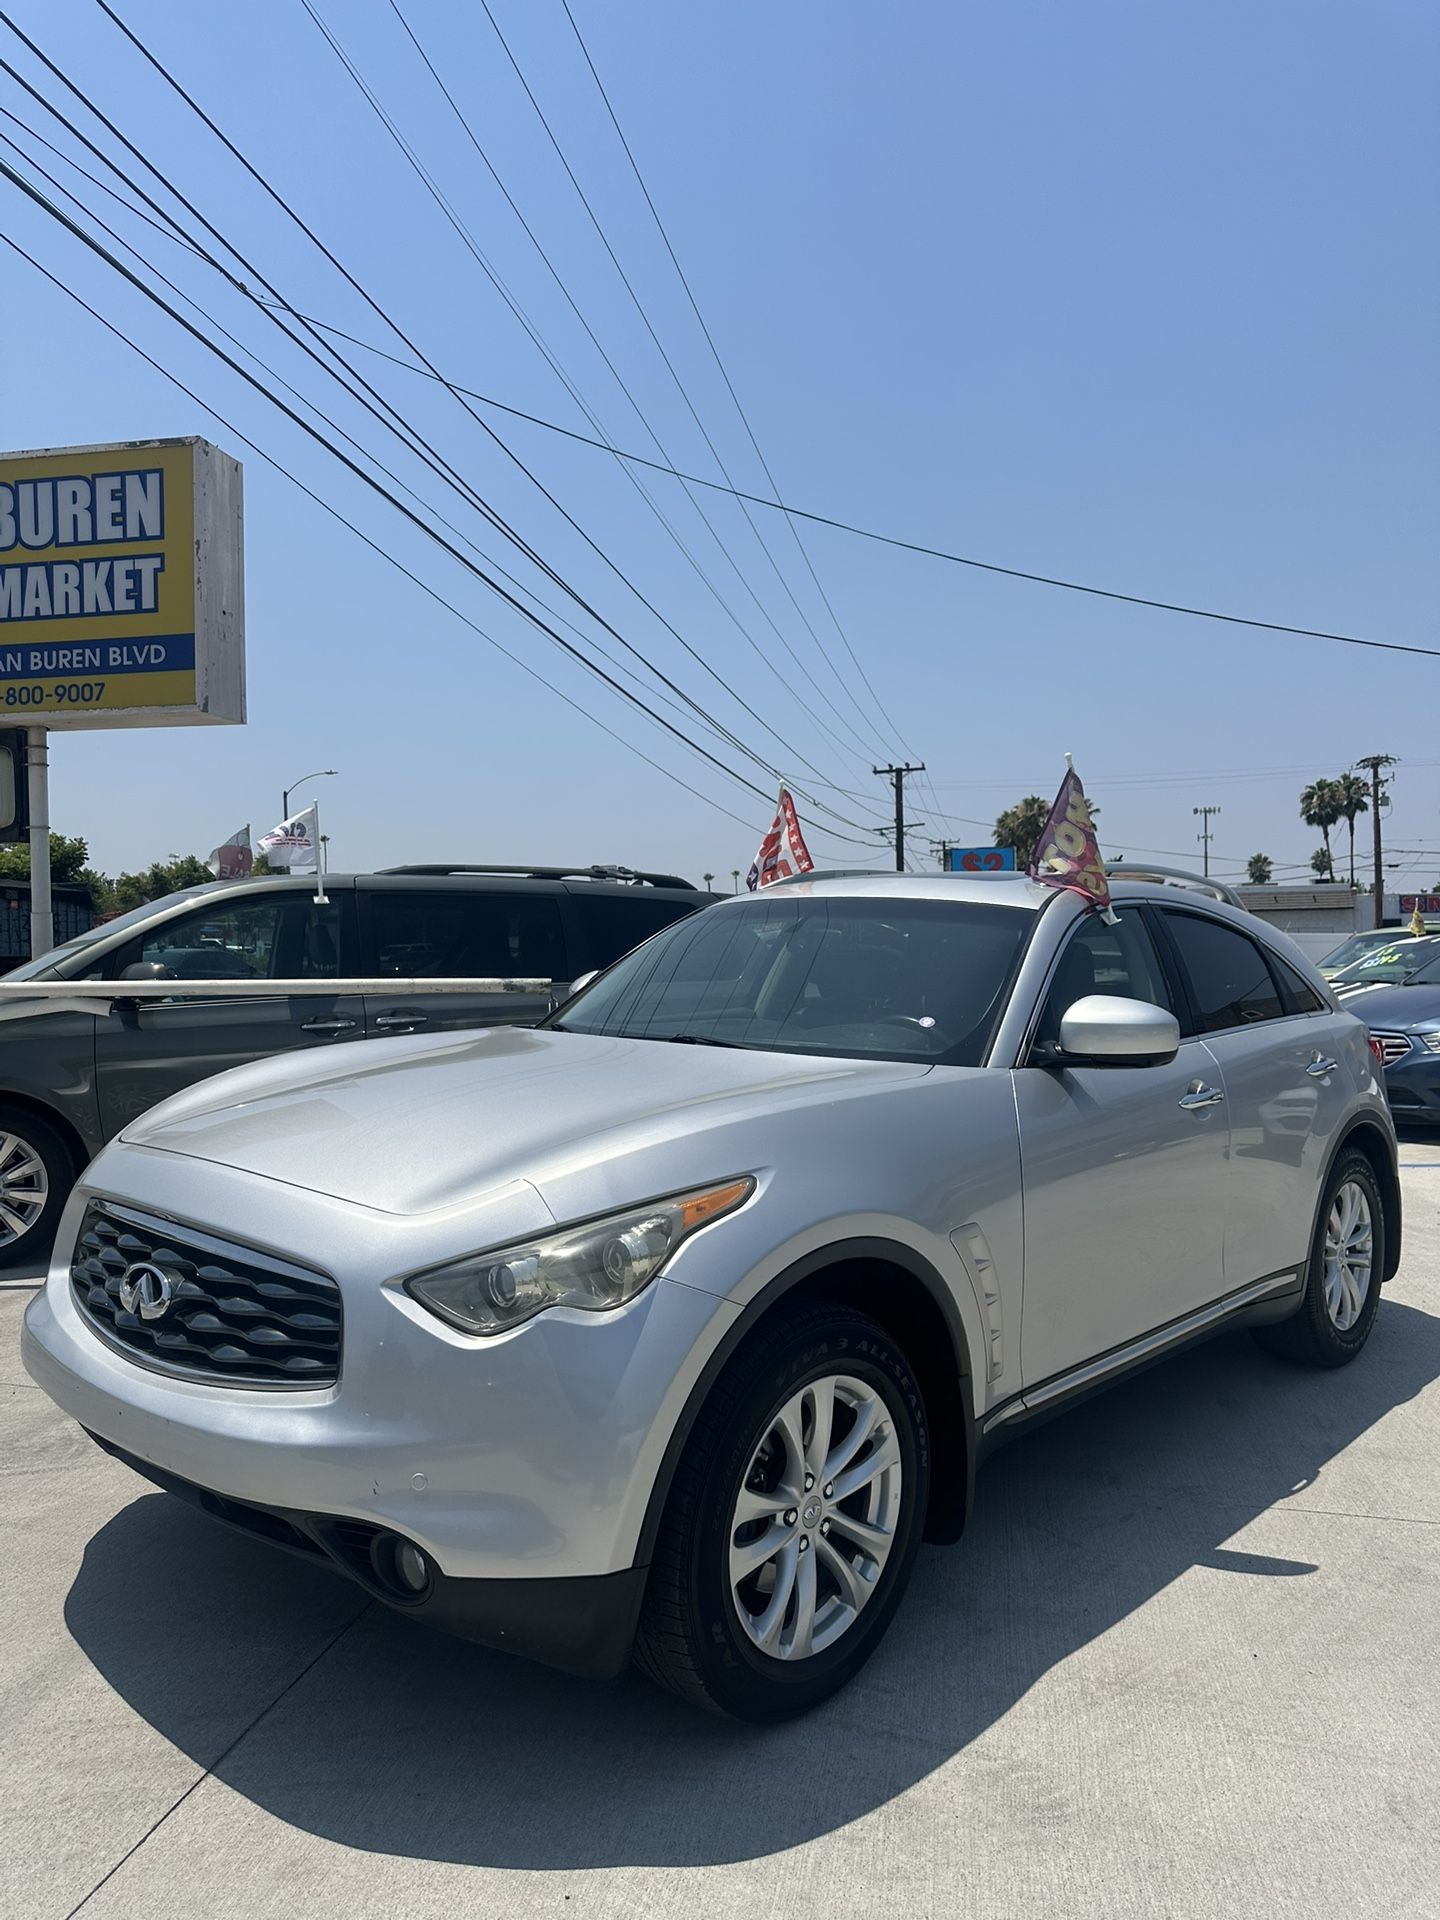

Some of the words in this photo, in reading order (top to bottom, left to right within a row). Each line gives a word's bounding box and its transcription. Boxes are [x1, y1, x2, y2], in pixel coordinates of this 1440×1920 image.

[30, 648, 101, 671] BUREN
[109, 644, 166, 667] BLVD
[835, 1336, 849, 1350] 3
